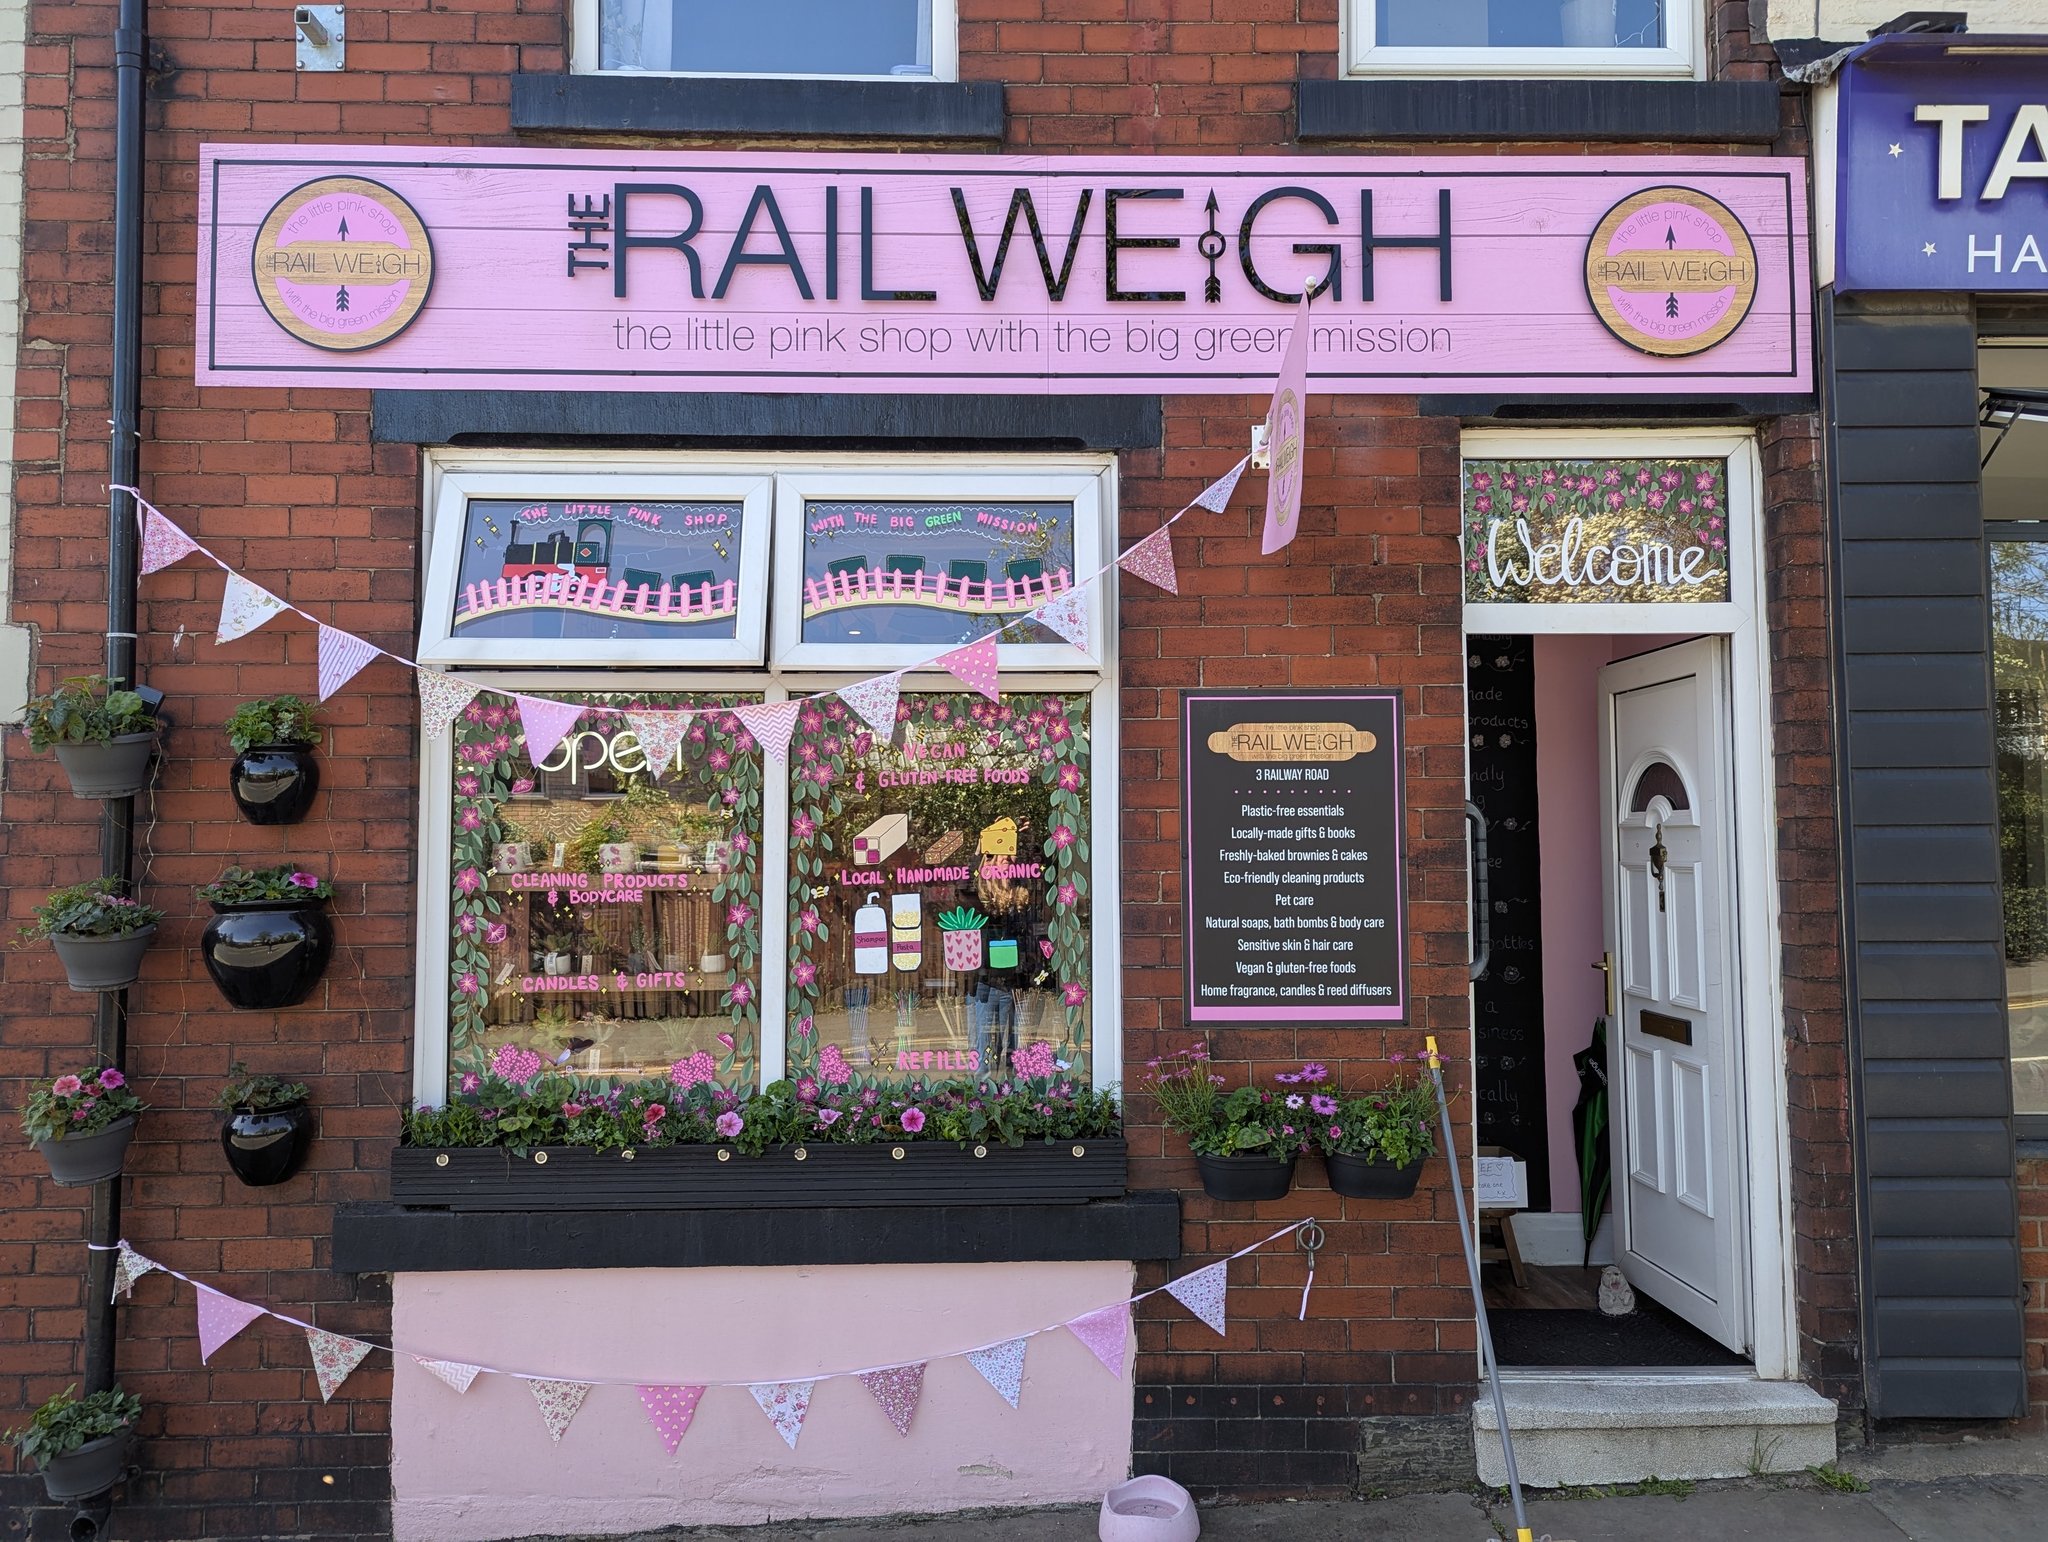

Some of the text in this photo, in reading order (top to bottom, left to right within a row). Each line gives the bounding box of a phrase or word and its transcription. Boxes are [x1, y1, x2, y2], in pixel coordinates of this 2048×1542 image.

[287, 199, 398, 236] the little pink shop
[1616, 208, 1722, 244] the little pink shop
[568, 193, 610, 278] THE
[614, 183, 937, 301] RAIL
[266, 253, 275, 269] THE
[273, 252, 326, 274] RAIL
[1605, 261, 1656, 281] RAIL
[286, 287, 401, 329] with the big green mission
[1617, 295, 1728, 336] with the big green mission
[612, 317, 671, 351] the
[687, 318, 755, 352] little
[769, 319, 847, 359] pink
[859, 319, 952, 360] shop
[966, 319, 1039, 353] with
[1056, 319, 1112, 353] the
[1126, 320, 1180, 361] big
[1313, 320, 1452, 353] mission
[521, 504, 728, 526] THE LITTLE PINK SHOP
[811, 511, 1038, 533] WITH THE BIG GREEN MISSION
[1487, 518, 1720, 588] Welcome
[903, 742, 966, 761] VEGAN
[1237, 733, 1282, 751] RAIL
[854, 772, 865, 794] &
[983, 767, 1030, 784] FOODS
[1256, 769, 1329, 780] 3 RAILWAY ROAD
[1241, 805, 1345, 817] Plastic-free essentials
[1231, 827, 1356, 841] Locally-made gifts & books
[1219, 849, 1368, 864] Freshly-baked brownies & cakes
[511, 873, 688, 889] CLEANING PRODUCTS
[842, 863, 1041, 886] LOCAL HANDMADE ORGANIC
[1224, 872, 1365, 885] Eco-friendly cleaning products
[548, 889, 643, 907] & BODYCARE
[1275, 894, 1314, 906] Pet care
[1205, 916, 1385, 930] Natural soaps, bath bombs & body care
[1237, 939, 1353, 951] Sensitive skin & hair care
[1235, 961, 1357, 976] Vegan & gluten-free foods
[523, 971, 686, 992] CANDLES & GIFTS
[1201, 984, 1392, 998] Home fragrance, candles & reed diffusers
[899, 1050, 981, 1071] REFILLS
